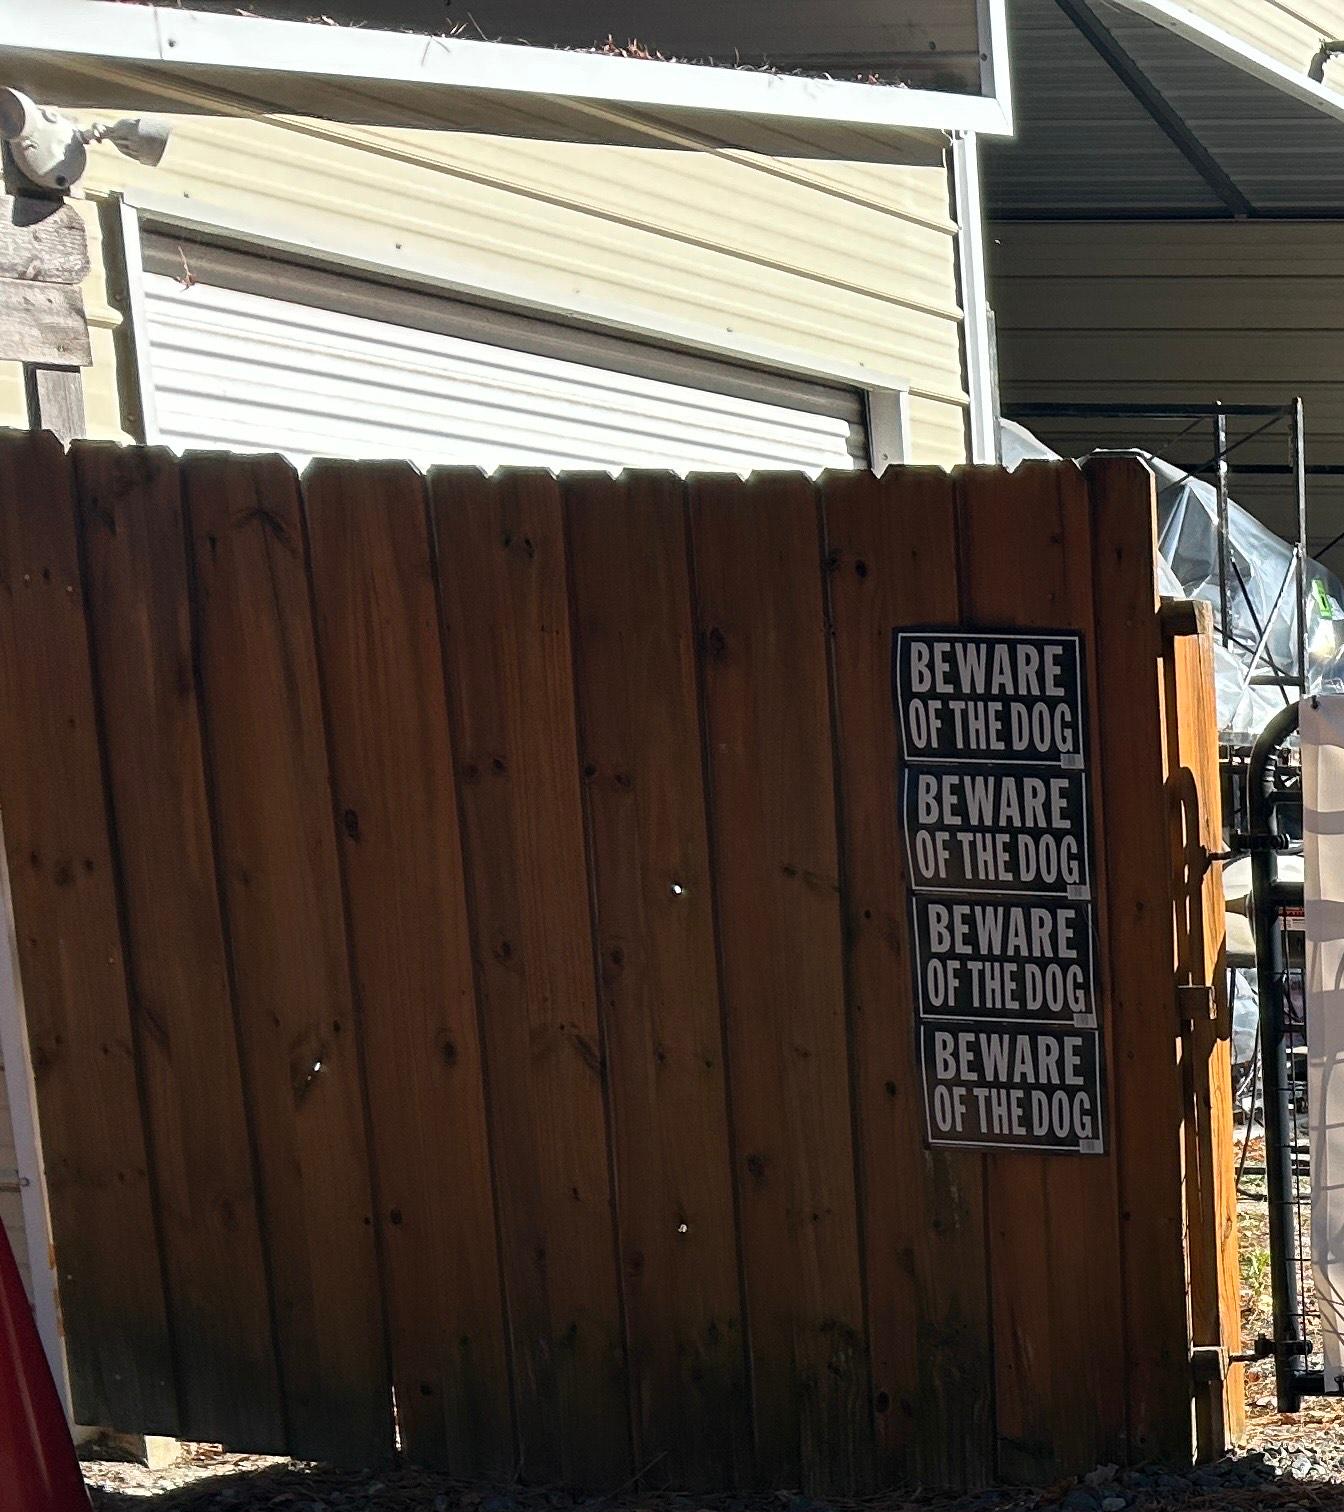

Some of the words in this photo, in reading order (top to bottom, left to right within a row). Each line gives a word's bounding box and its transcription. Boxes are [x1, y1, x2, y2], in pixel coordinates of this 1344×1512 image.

[910, 641, 1065, 697] BEWARE
[908, 698, 942, 749] OF
[948, 700, 1006, 750] THE
[1010, 701, 1073, 753] DOG
[918, 774, 1071, 829] BEWARE
[915, 829, 950, 879] OF
[956, 831, 1014, 882] THE
[1017, 833, 1080, 884] DOG
[927, 903, 1078, 959] BEWARE
[926, 958, 961, 1007] OF
[966, 960, 1020, 1010] THE
[1024, 963, 1086, 1013] DOG
[934, 1031, 1084, 1085] BEWARE
[933, 1084, 967, 1132] OF
[972, 1087, 1027, 1136] THE
[1031, 1090, 1093, 1138] DOG
